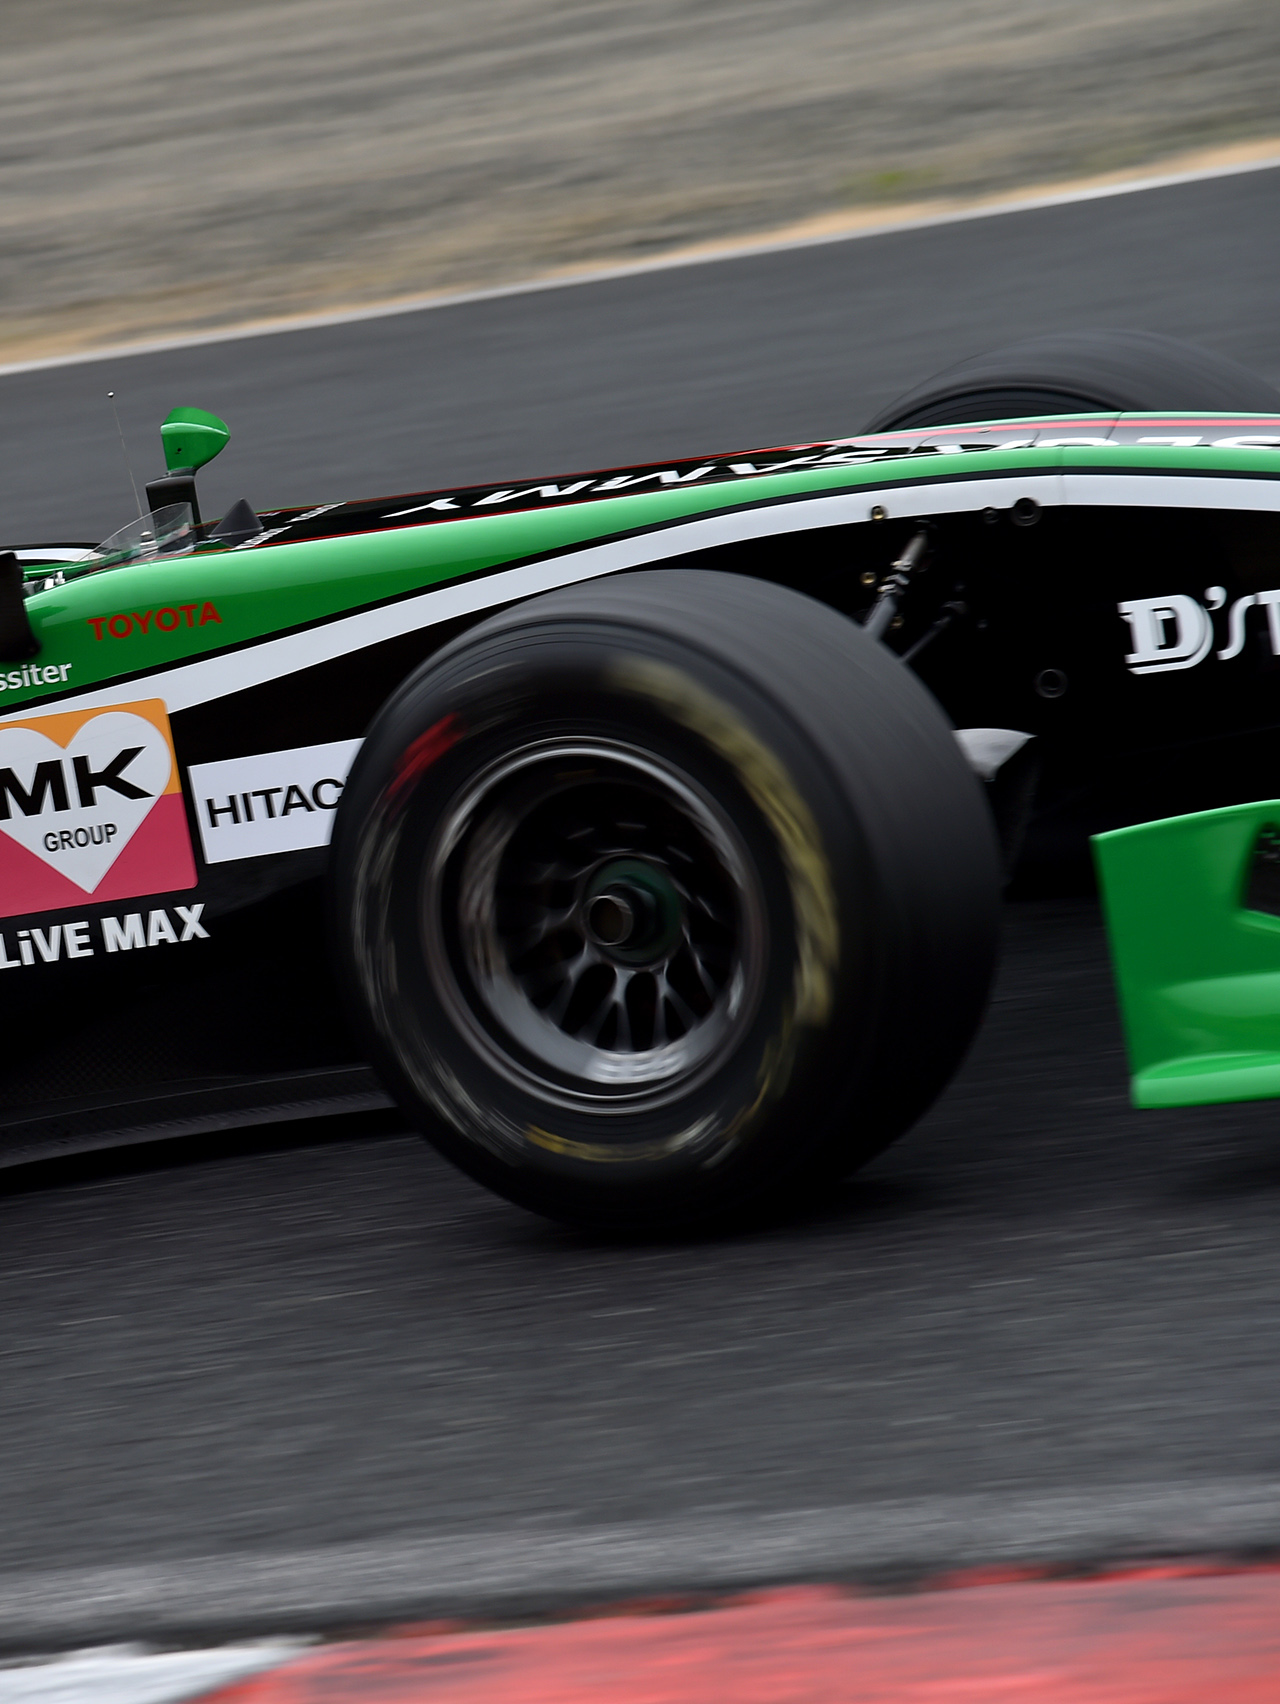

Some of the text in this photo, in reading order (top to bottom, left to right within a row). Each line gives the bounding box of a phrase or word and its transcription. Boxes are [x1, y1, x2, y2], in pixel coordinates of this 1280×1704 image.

[88, 602, 222, 641] TOYOTA
[205, 776, 351, 828] HITAC
[43, 823, 118, 852] GROUP
[100, 903, 211, 953] MAX
